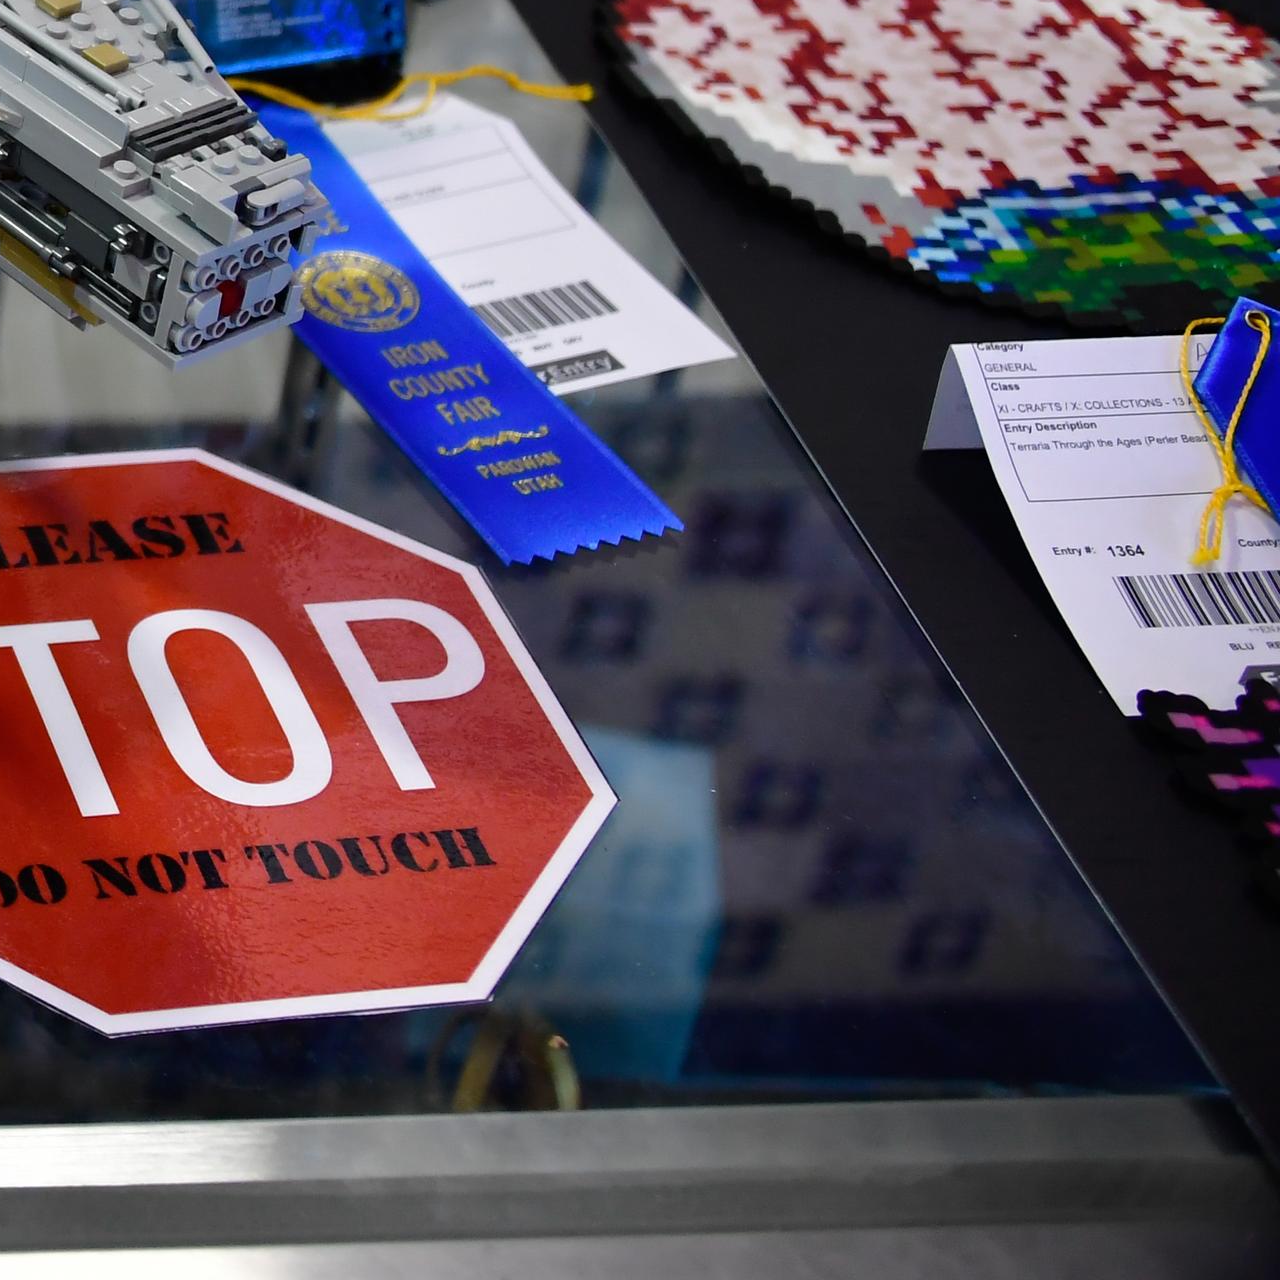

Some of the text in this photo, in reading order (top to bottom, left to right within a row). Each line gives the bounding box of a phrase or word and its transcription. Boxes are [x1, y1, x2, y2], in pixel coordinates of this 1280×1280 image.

[380, 340, 450, 368] IRON
[977, 343, 1024, 353] Category
[984, 362, 1037, 372] GENERAL
[390, 363, 490, 400] COUNTY
[990, 382, 1020, 391] Class
[436, 396, 501, 426] FAIR
[998, 404, 1009, 413] XI
[1017, 402, 1062, 413] CRAFTS
[1084, 397, 1163, 410] COLLECTIONS
[1173, 397, 1185, 406] 13
[1004, 420, 1098, 434] Entry Description
[1010, 441, 1050, 451] Terraria
[1052, 438, 1096, 451] Through
[1097, 438, 1114, 448] the
[1116, 436, 1142, 448] Ages
[1144, 434, 1178, 446] (Perler
[512, 473, 564, 496] UTAH
[1052, 546, 1082, 556] Entry
[1107, 545, 1145, 558] 1364
[1229, 642, 1255, 651] BLU
[82, 848, 230, 900] NOT
[245, 827, 497, 886] TOUCH
